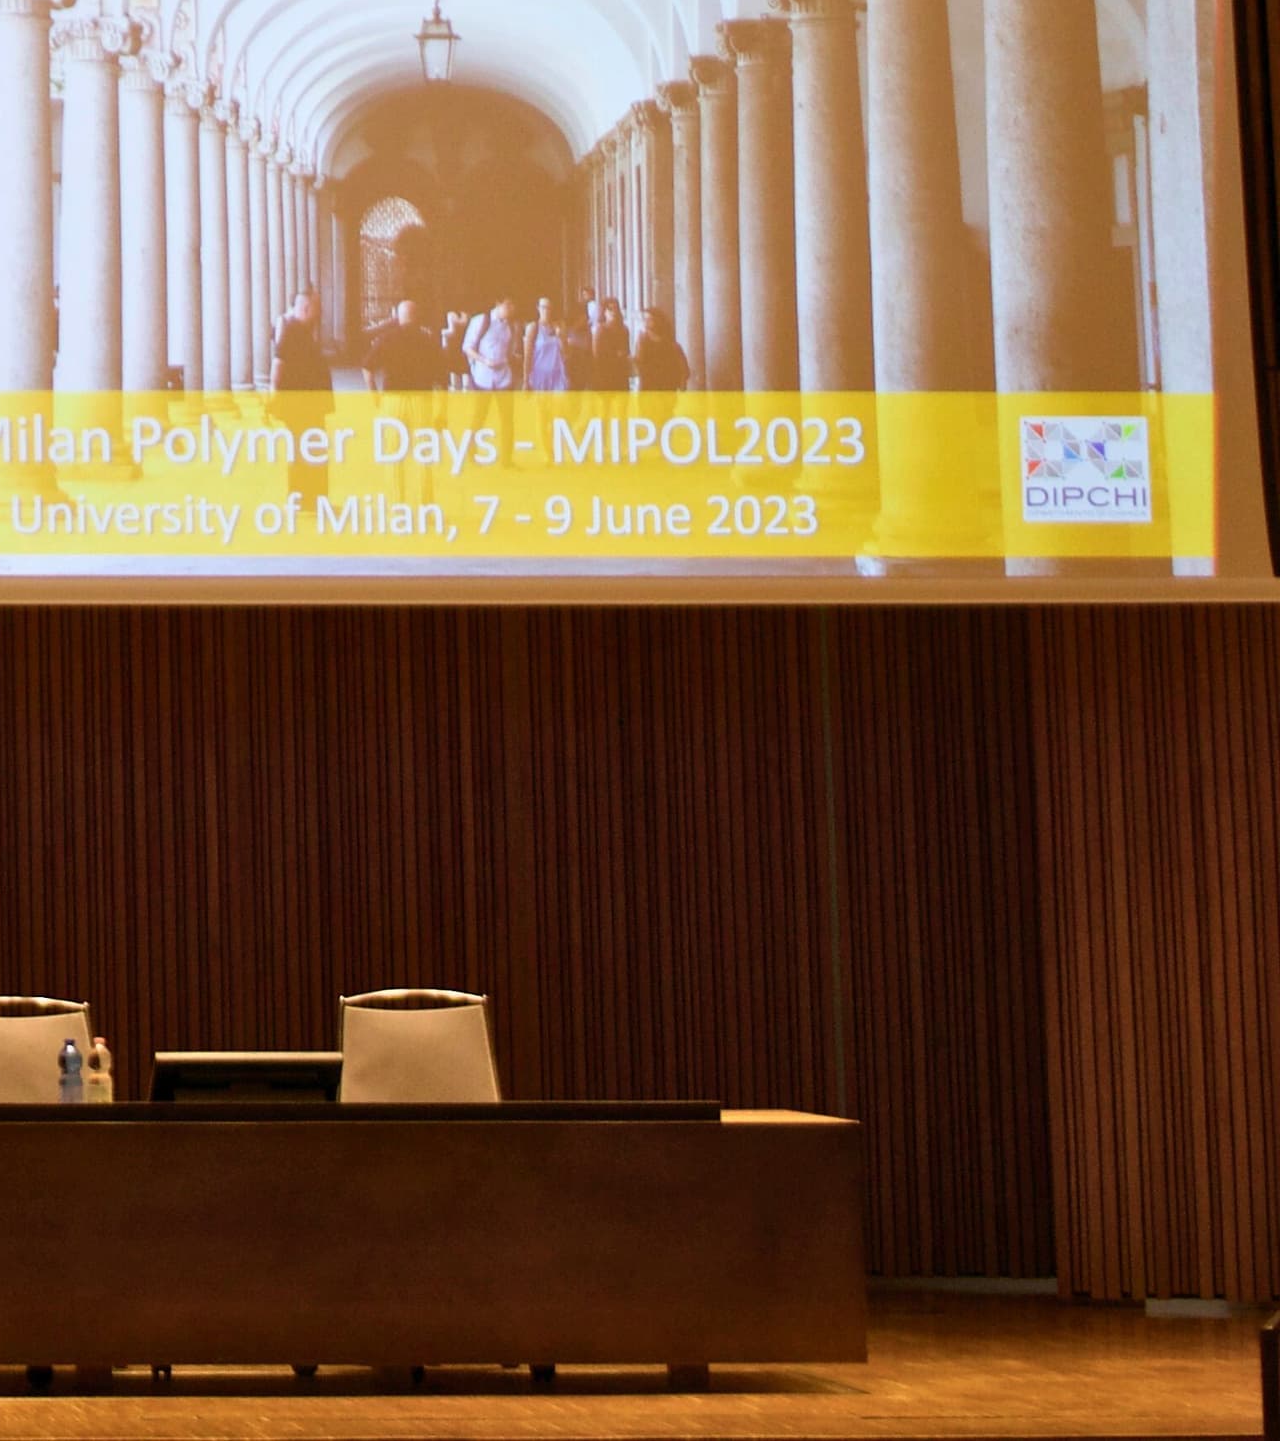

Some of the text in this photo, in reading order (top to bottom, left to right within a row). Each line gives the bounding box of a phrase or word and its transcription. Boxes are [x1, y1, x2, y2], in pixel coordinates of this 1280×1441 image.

[132, 413, 355, 475] Polymer
[372, 416, 498, 475] Days
[551, 416, 866, 465] MIPOL2023
[9, 495, 241, 545] University
[254, 492, 303, 535] of
[315, 494, 458, 542] Milan,
[472, 495, 501, 535] 7
[543, 494, 573, 536] 9
[585, 494, 692, 536] June
[706, 494, 820, 536] 2023
[1025, 486, 1148, 507] DIPCHI
